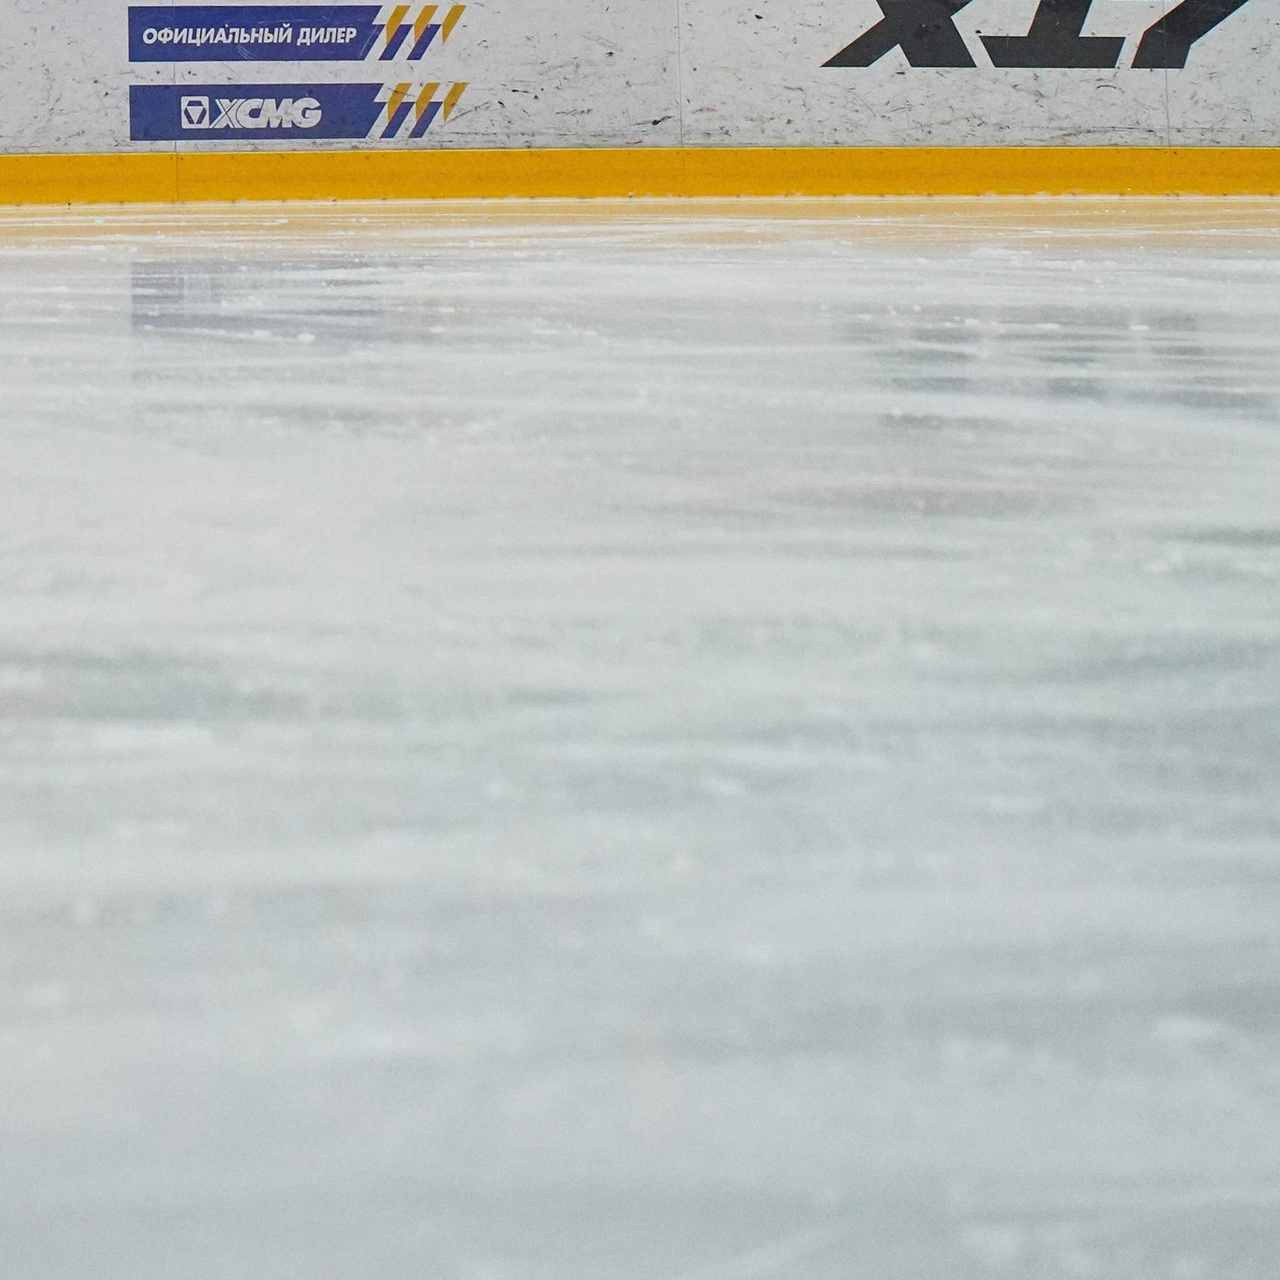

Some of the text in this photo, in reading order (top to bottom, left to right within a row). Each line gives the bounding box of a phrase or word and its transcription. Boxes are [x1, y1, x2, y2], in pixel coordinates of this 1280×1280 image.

[142, 23, 357, 46] ОФИЦИАЛЬНЫЙ ДИЛЕР
[208, 97, 322, 129] XCMG
